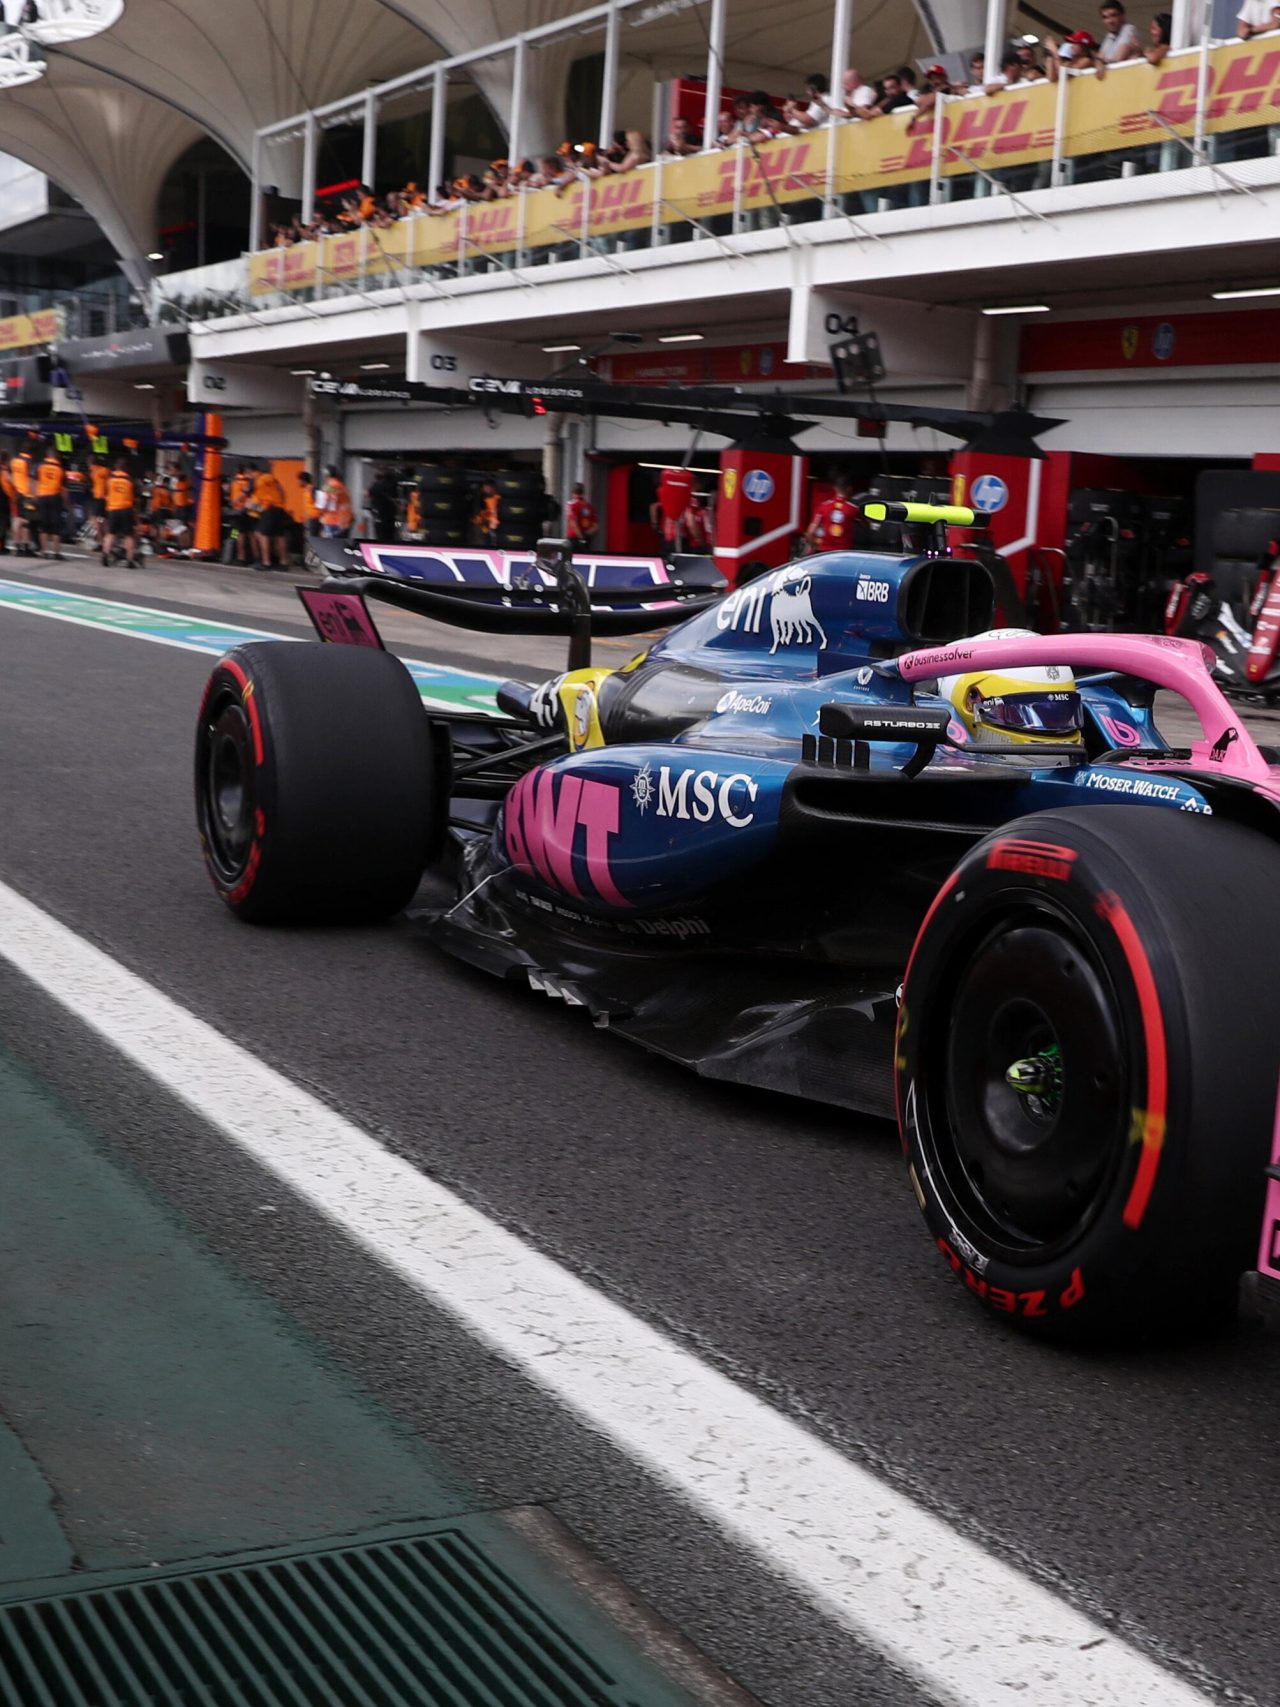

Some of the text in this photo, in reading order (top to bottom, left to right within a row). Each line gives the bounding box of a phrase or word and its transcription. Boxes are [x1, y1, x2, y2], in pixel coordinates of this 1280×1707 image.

[903, 101, 1031, 168] DHL
[717, 144, 813, 203] DHL
[824, 313, 859, 338] 04
[430, 354, 457, 371] 03
[469, 376, 520, 394] CEVA
[867, 581, 890, 604] BRB
[717, 587, 768, 633] eni
[914, 651, 975, 669] businessolver
[656, 766, 759, 828] MSC
[1086, 772, 1180, 801] MOSER.WATCH
[505, 765, 637, 908] BWT
[635, 916, 712, 940] Delphi
